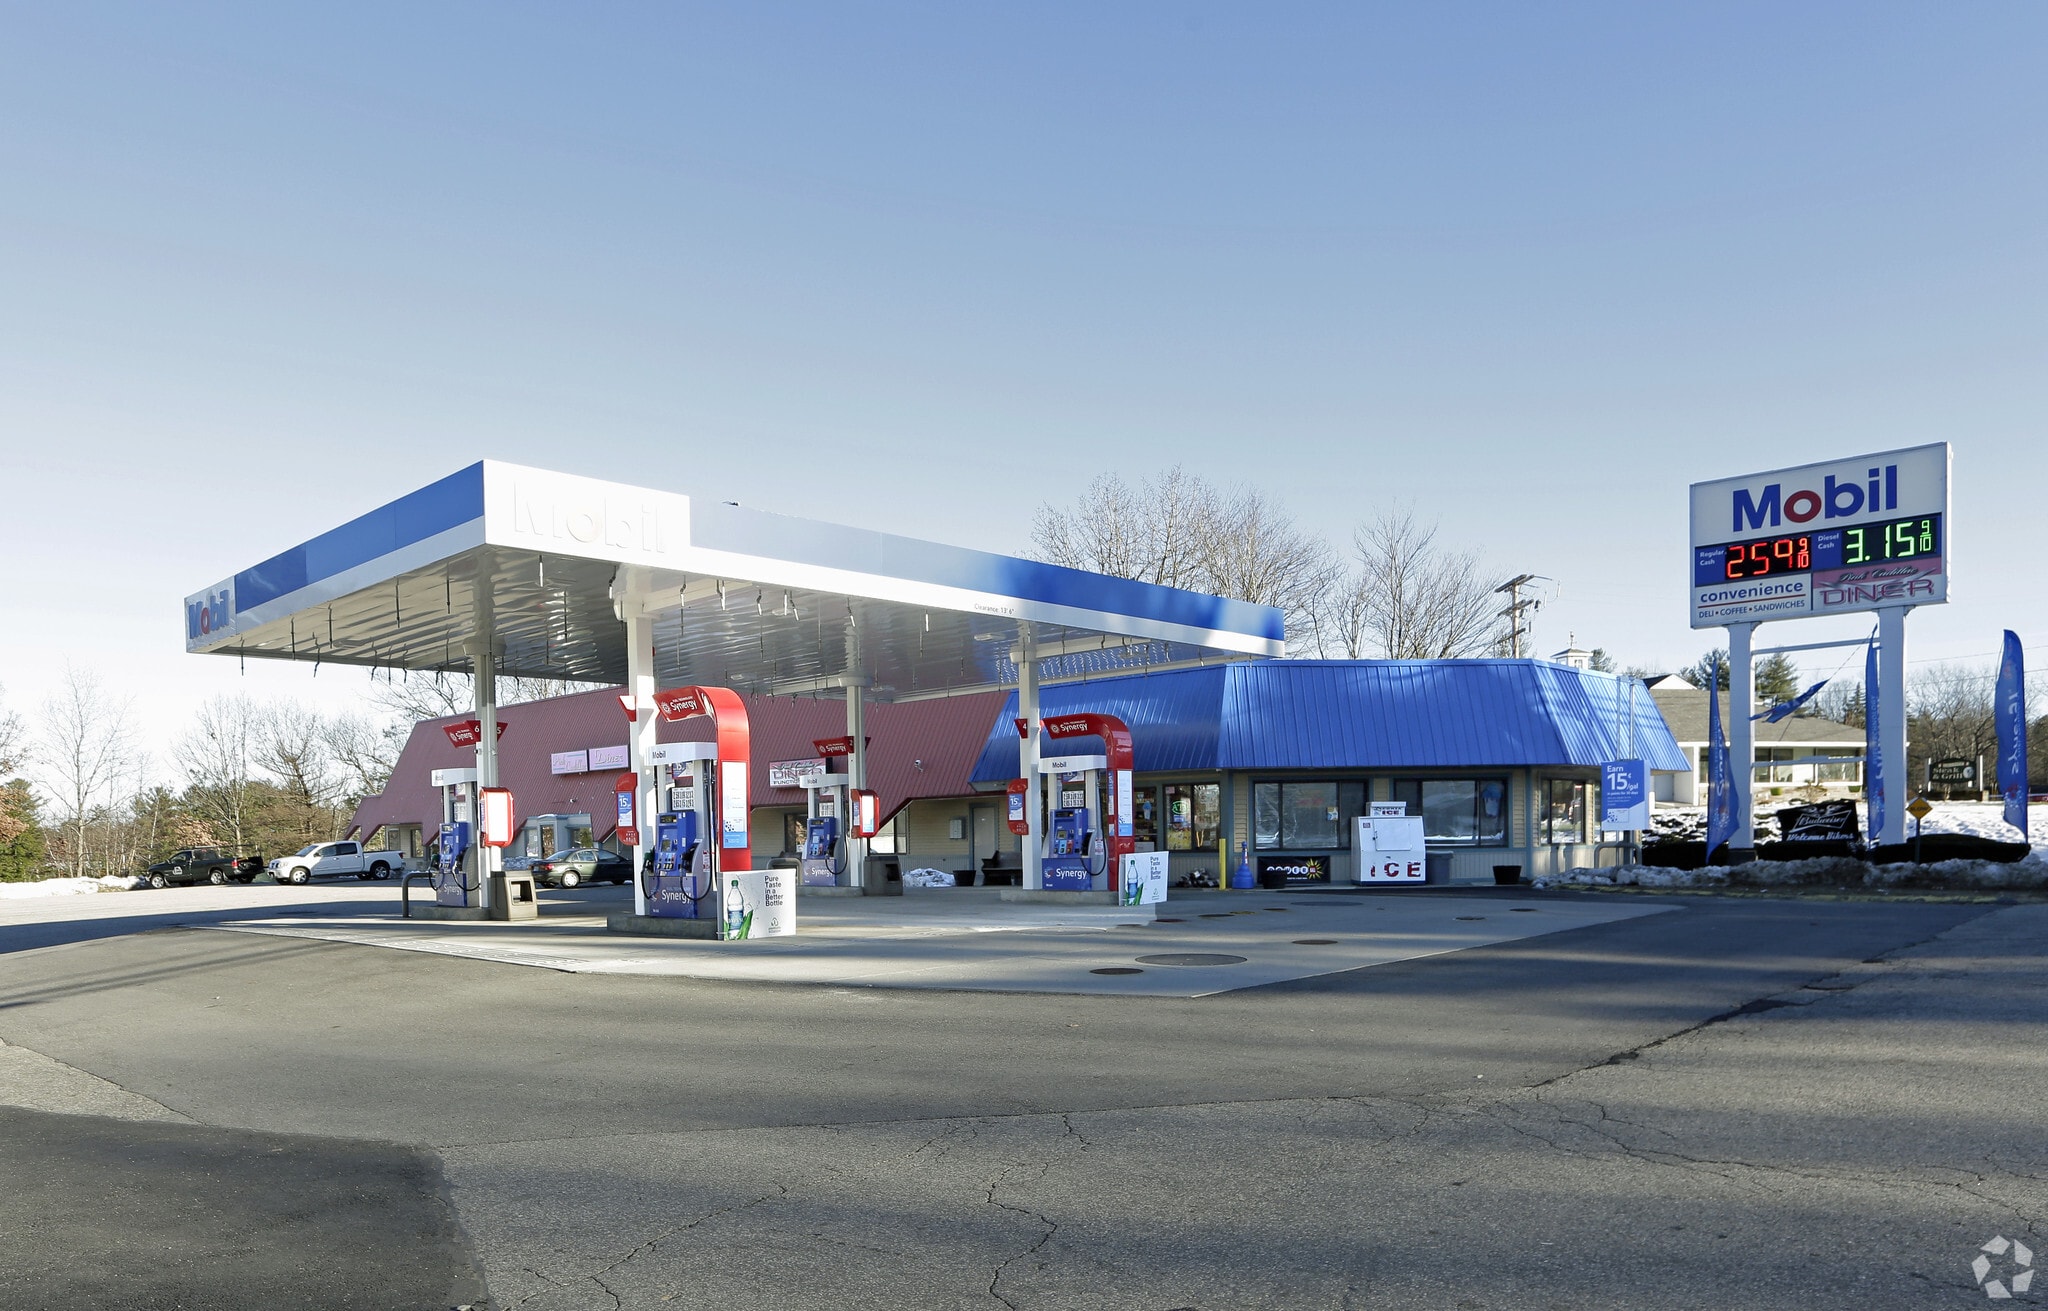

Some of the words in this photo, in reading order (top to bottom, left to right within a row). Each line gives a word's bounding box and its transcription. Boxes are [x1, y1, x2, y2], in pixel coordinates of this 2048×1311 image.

[1732, 464, 1898, 533] Mobil
[514, 480, 666, 553] Mobil
[1817, 533, 1839, 542] Diesel
[1846, 521, 1915, 564] 3.15
[1817, 542, 1834, 550] Cash
[1699, 550, 1724, 559] Regular
[1727, 539, 1793, 578] 259
[1700, 582, 1803, 603] convenience
[1819, 579, 1935, 606] DINER
[189, 589, 229, 640] Mobil
[1699, 610, 1714, 618] DELI
[1720, 606, 1747, 616] COFFEE
[1753, 600, 1805, 613] SANDWICHES
[670, 700, 697, 712] Synergy
[474, 725, 480, 733] 6
[1060, 723, 1087, 732] Synergy
[652, 751, 667, 759] Mobil
[1799, 816, 1844, 826] Budweiser
[1056, 868, 1088, 880] Synergy
[1370, 862, 1421, 878] ICE
